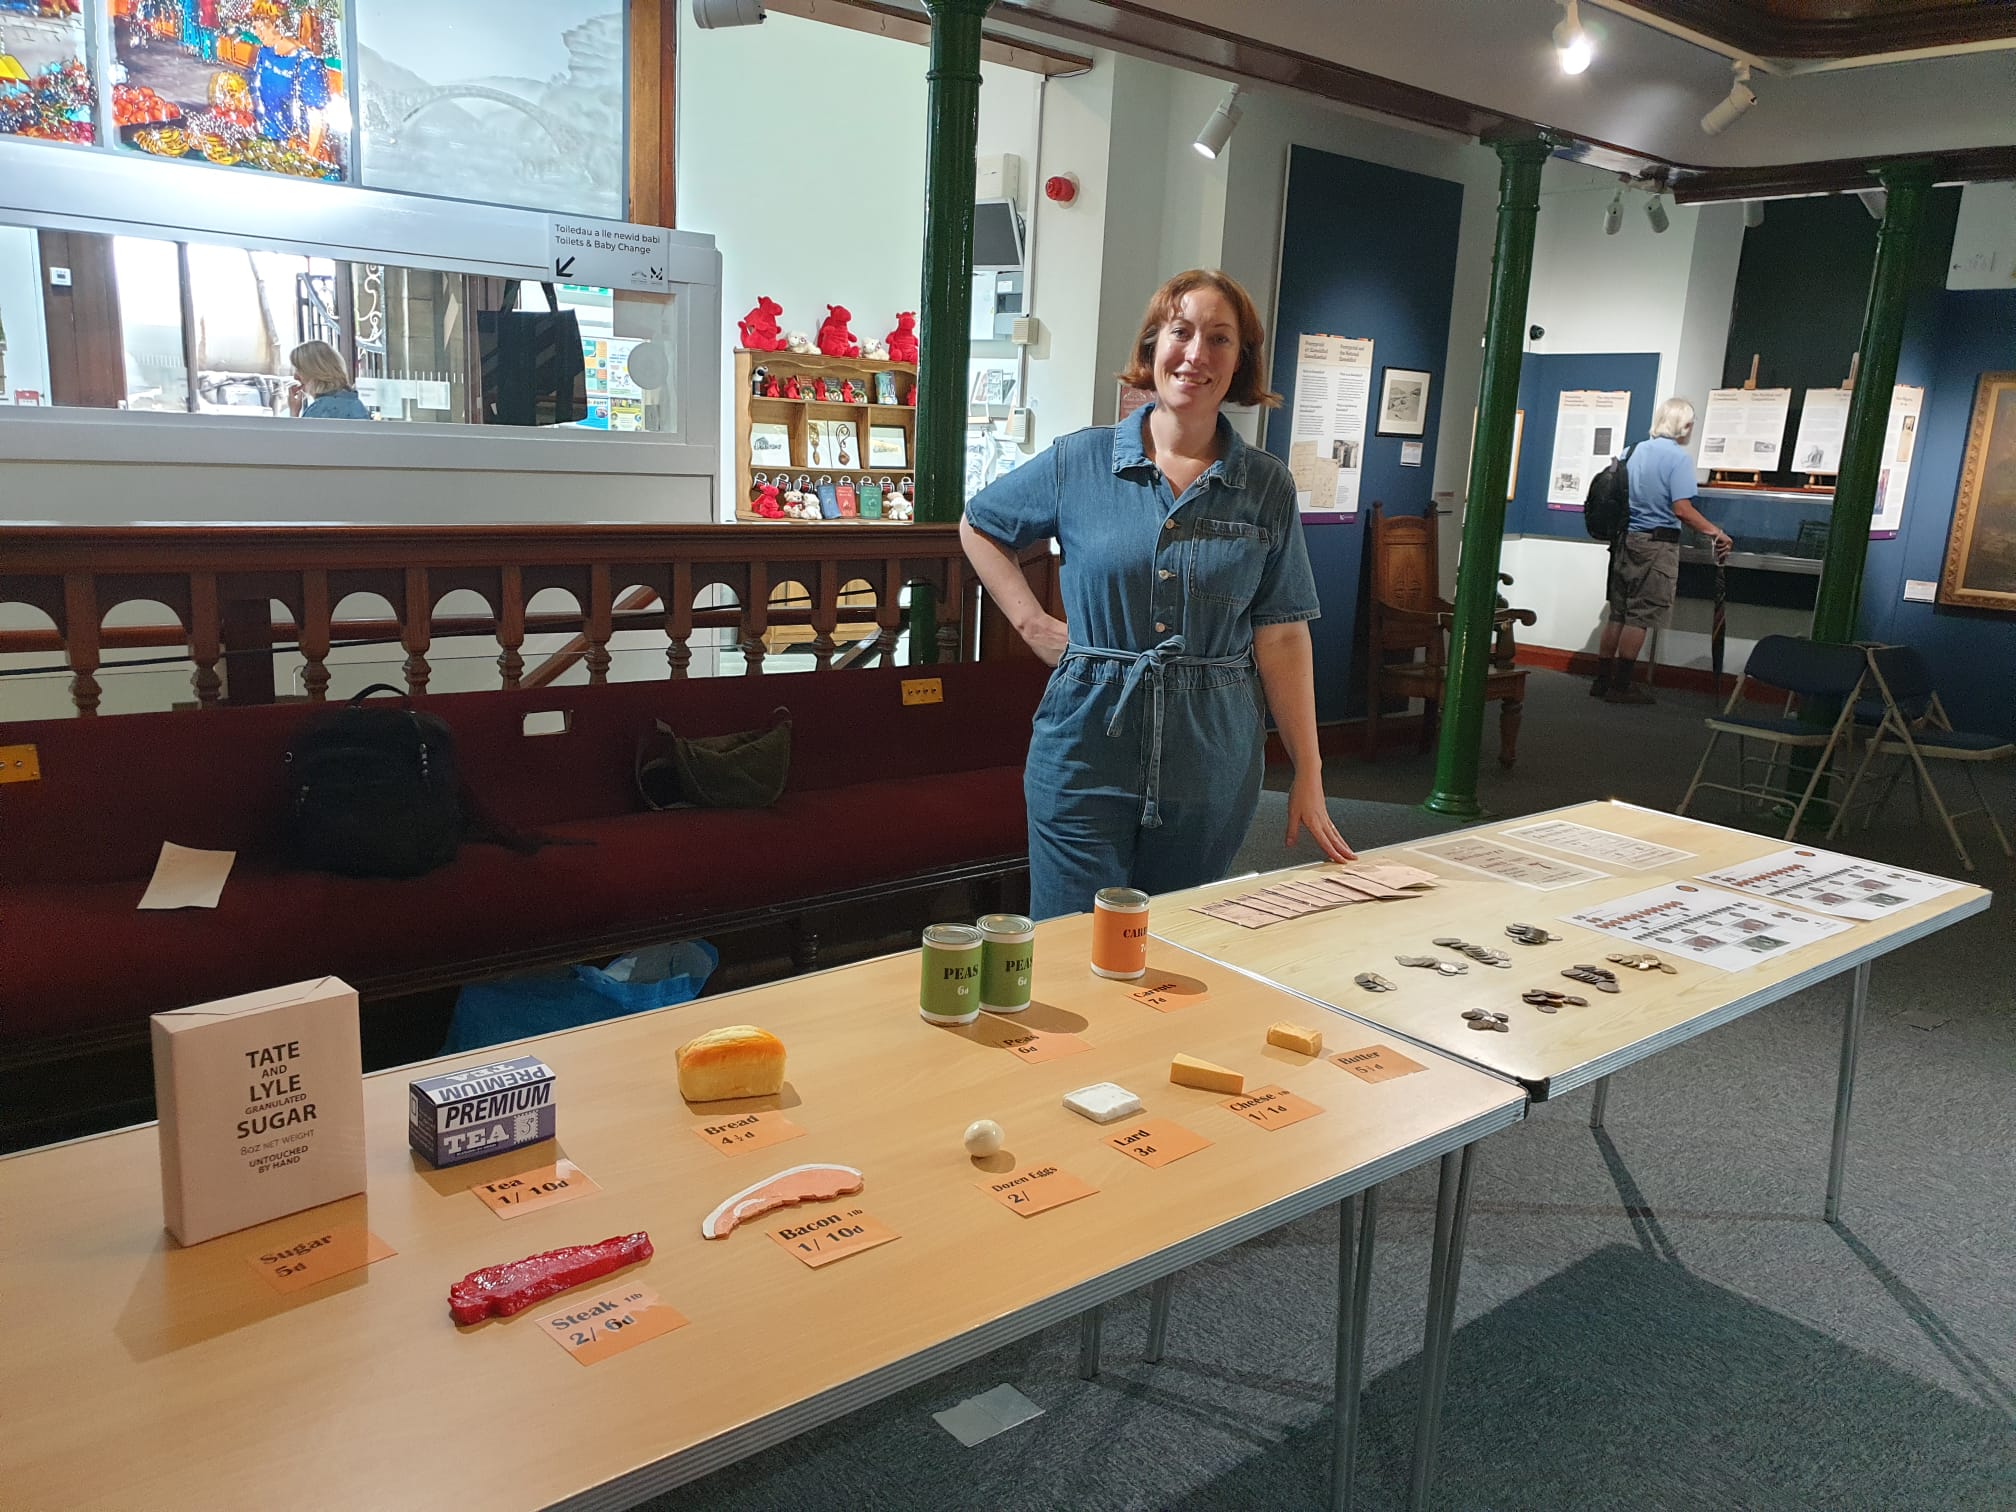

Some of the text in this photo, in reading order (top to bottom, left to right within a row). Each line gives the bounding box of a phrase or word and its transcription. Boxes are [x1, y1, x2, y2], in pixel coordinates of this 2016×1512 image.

[555, 224, 592, 236] Toiledau
[601, 231, 612, 239] lle
[614, 232, 640, 242] newid
[641, 235, 660, 244] babi
[555, 235, 651, 255] Toilets & Baby Change
[943, 963, 979, 980] PEAS
[957, 985, 969, 996] 6d
[1133, 983, 1177, 998] Carrots
[1148, 997, 1167, 1005] 7d
[1003, 1034, 1040, 1047] Peas
[1017, 1045, 1038, 1054] 6d
[245, 1041, 300, 1069] TATE
[1337, 1051, 1380, 1065] Butter
[261, 1064, 287, 1079] AND
[249, 1074, 302, 1103] LYLE
[439, 1066, 547, 1102] PREMIUM
[245, 1093, 307, 1115] GRANULATED
[445, 1083, 551, 1129] PREMIUM
[1230, 1093, 1277, 1111] Cheese
[236, 1103, 317, 1140] SUGAR
[703, 1115, 760, 1136] Bread
[262, 1138, 279, 1149] NET
[281, 1129, 315, 1145] WEIGHT
[443, 1123, 510, 1155] TEA
[1113, 1129, 1152, 1146] Lard
[248, 1145, 309, 1168] UNTOUCHED
[1133, 1145, 1158, 1157] 3d
[258, 1155, 301, 1174] BY HAND
[481, 1179, 526, 1193] Tea
[529, 1179, 570, 1195] 10d
[991, 1166, 1058, 1193] Dozen Eggs
[778, 1213, 843, 1241] Bacon
[826, 1224, 865, 1243] 10d
[259, 1235, 333, 1265] Sugar
[275, 1262, 307, 1278] 5d
[550, 1300, 620, 1331] Steak
[604, 1314, 636, 1331] 6d
